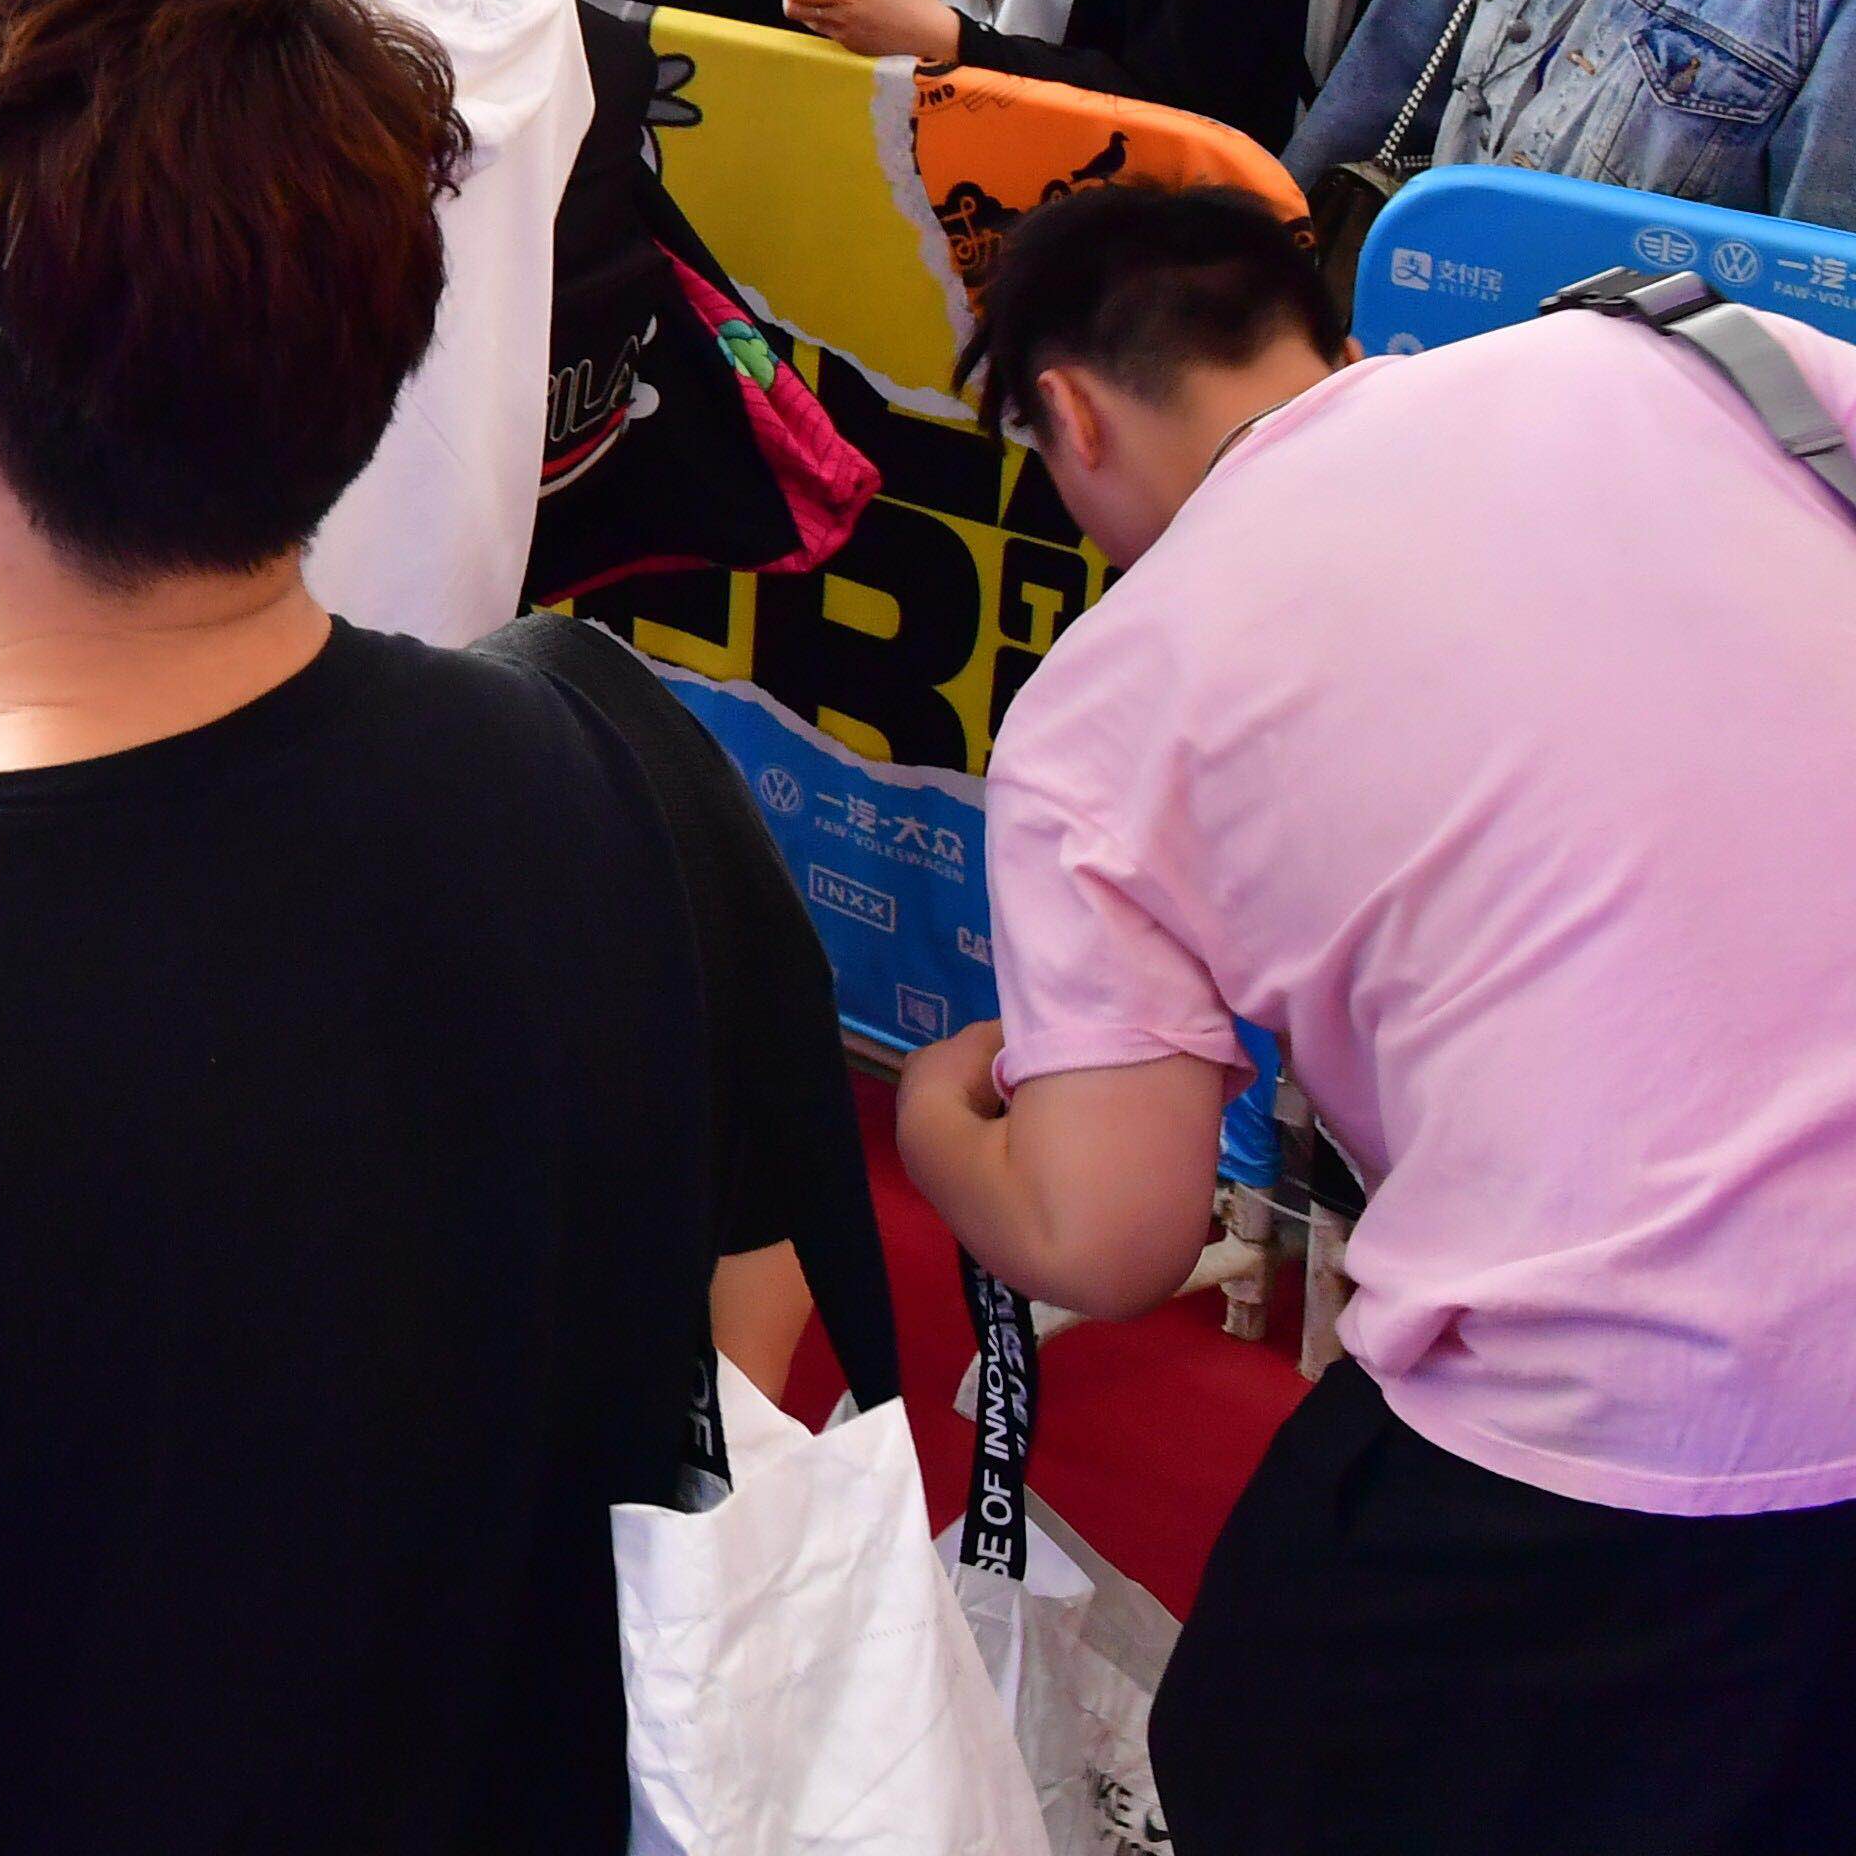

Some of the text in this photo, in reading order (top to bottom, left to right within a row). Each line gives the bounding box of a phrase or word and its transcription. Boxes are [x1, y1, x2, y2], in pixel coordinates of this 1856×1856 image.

[1437, 258, 1505, 294] 支付宝
[816, 875, 886, 919] INXX
[980, 1468, 1015, 1528] OF
